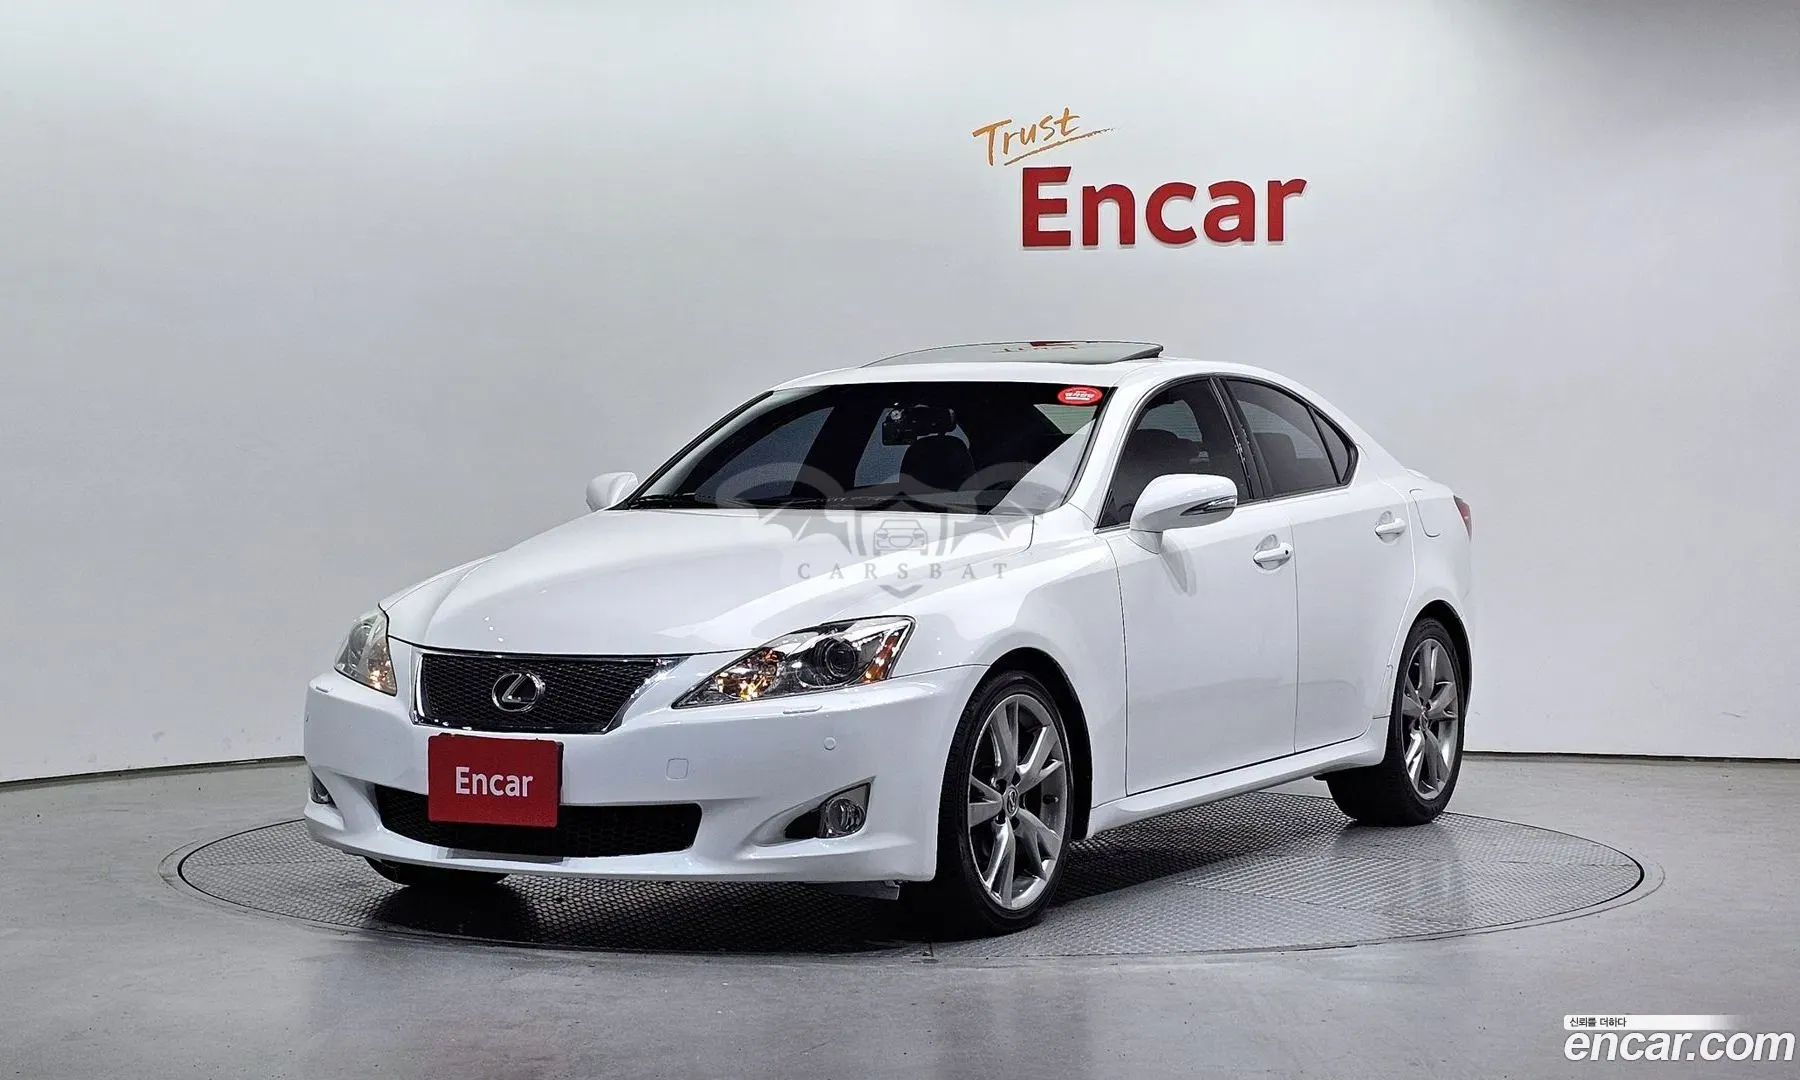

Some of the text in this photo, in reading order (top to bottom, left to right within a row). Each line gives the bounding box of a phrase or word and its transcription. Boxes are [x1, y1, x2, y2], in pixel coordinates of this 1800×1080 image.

[972, 107, 1080, 166] Trust
[1022, 166, 1307, 248] Encar
[455, 766, 534, 797] Encar
